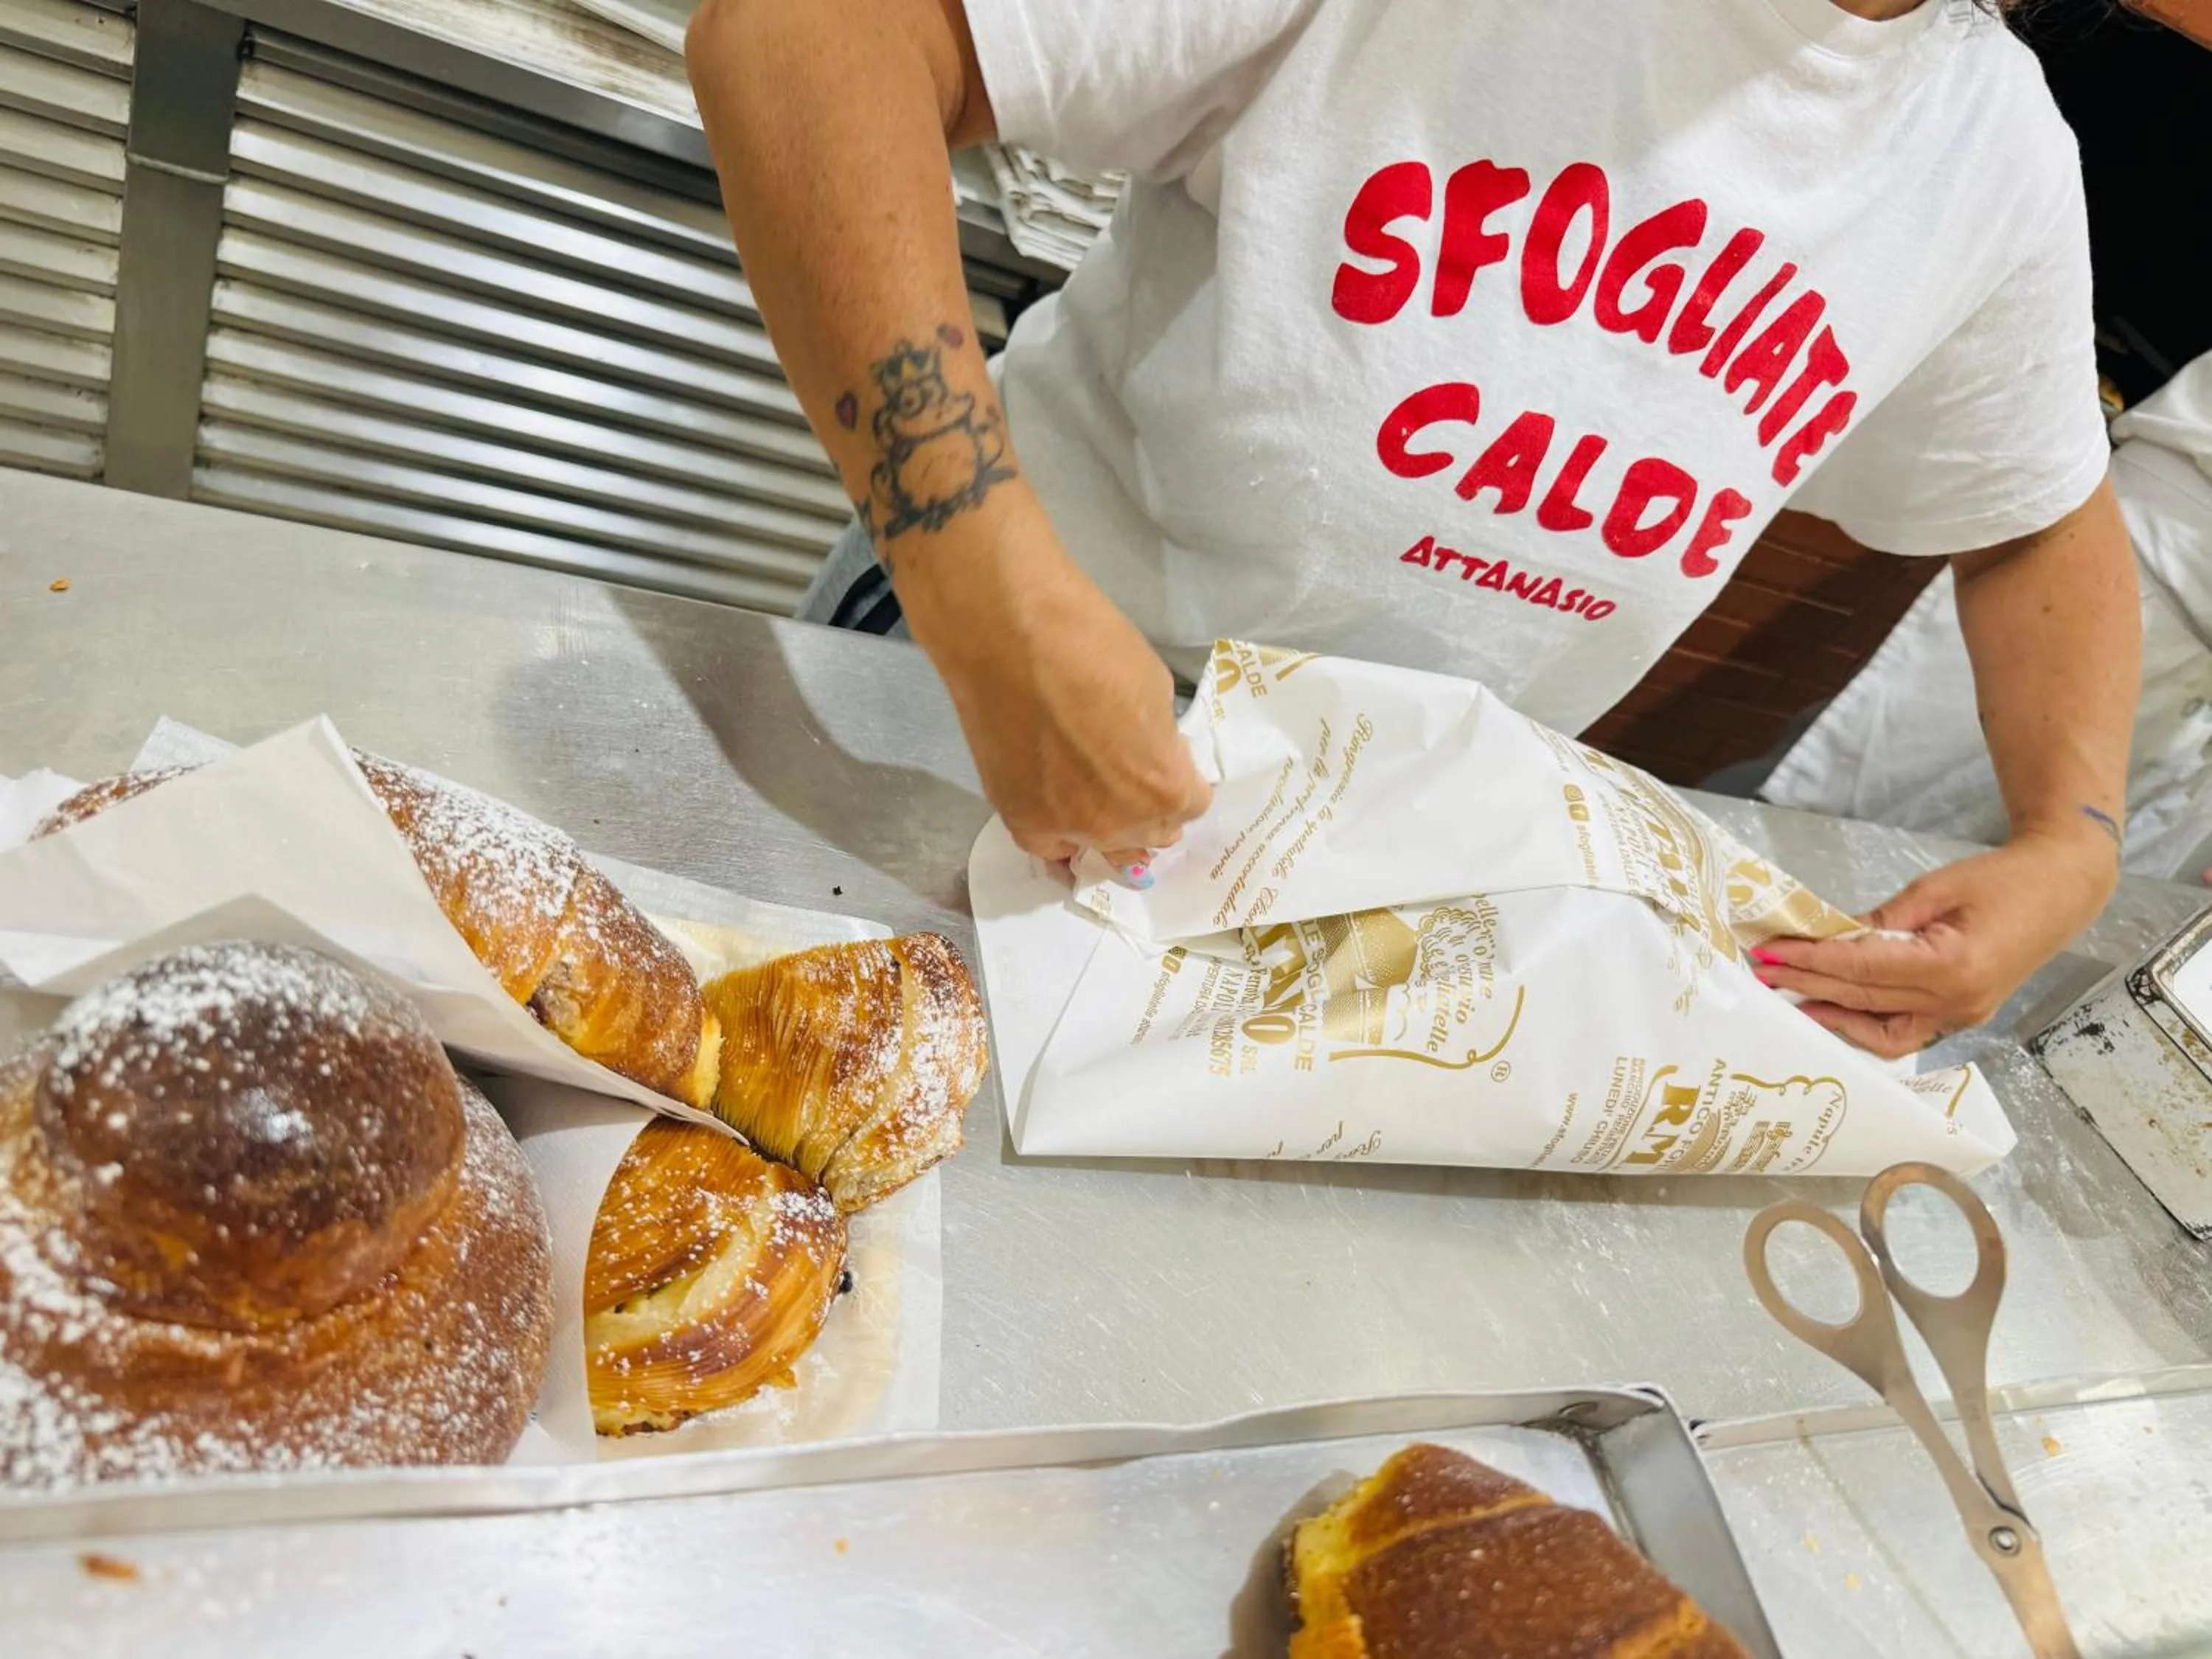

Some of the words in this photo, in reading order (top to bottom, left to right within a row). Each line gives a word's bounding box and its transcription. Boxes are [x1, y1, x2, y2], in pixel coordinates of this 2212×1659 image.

[1331, 159, 1857, 487] SFOGLIATE
[1377, 382, 1753, 579] CALDE
[1400, 535, 1617, 621] ATTANASIO
[1688, 1058, 1727, 1135] ANTICO
